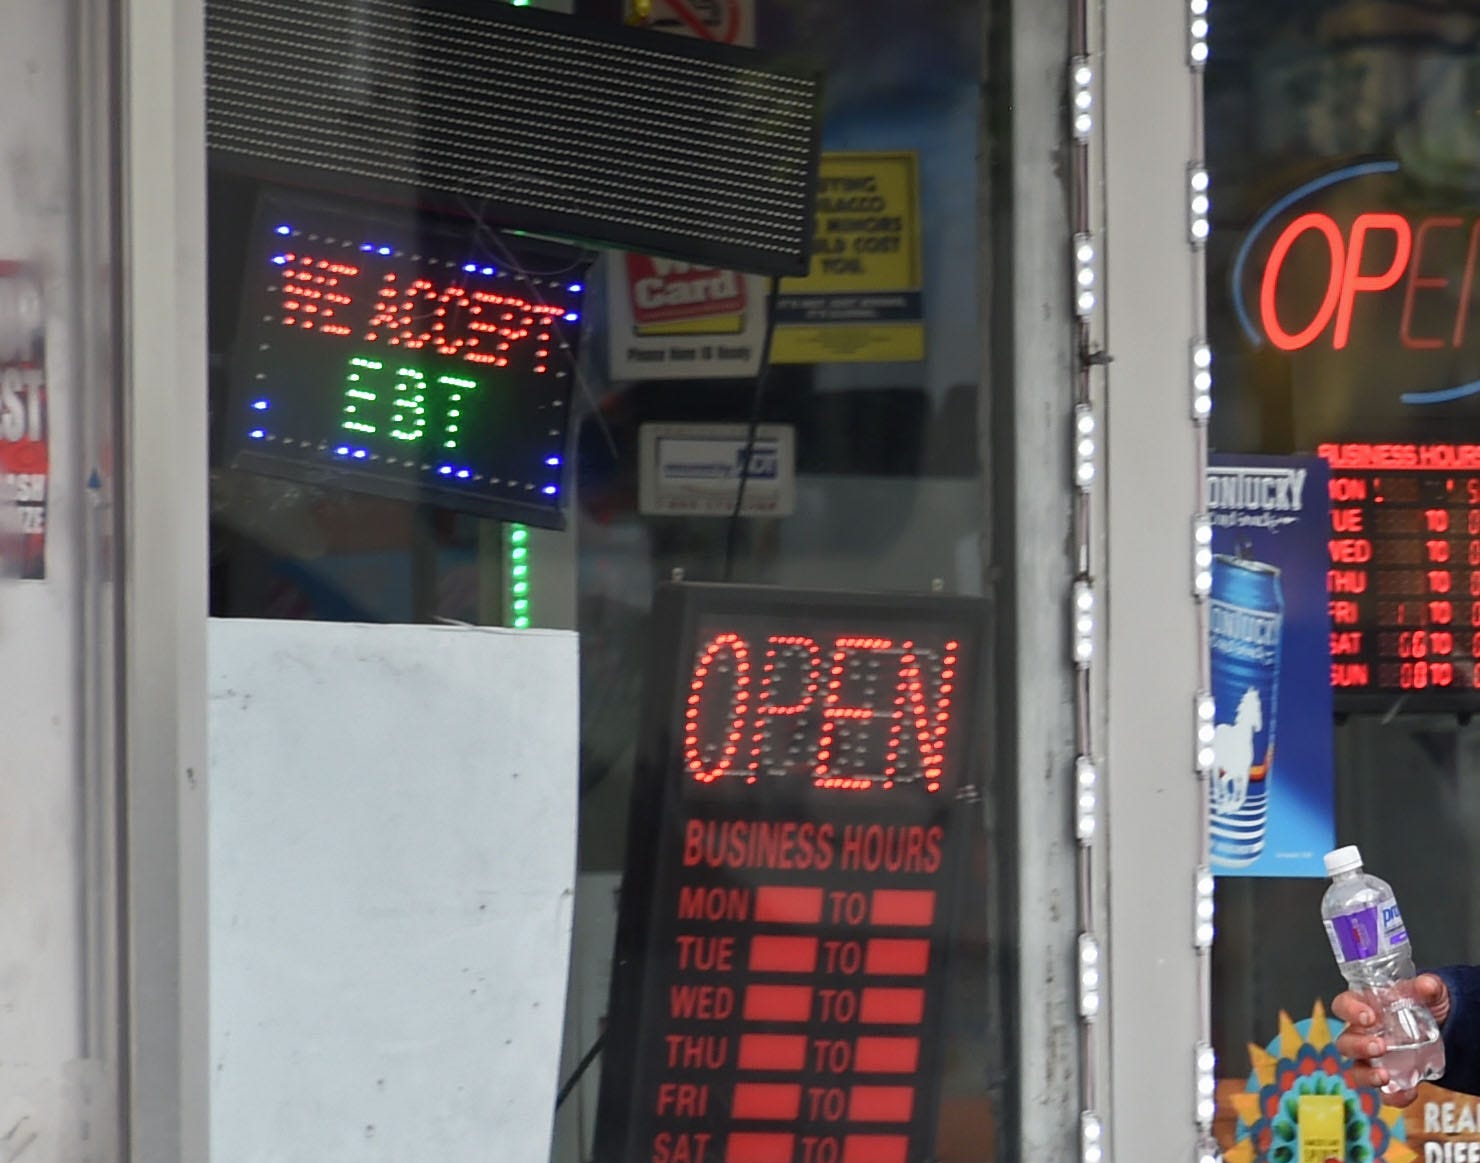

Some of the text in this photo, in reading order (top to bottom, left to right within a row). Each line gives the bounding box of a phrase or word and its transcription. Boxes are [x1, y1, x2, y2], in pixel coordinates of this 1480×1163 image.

[634, 274, 738, 310] Card
[342, 356, 478, 446] EBT
[684, 632, 960, 791] OPEN
[683, 819, 944, 874] BUSINESS HOURS
[678, 886, 867, 925] MON TO
[676, 935, 861, 976] TUE TO
[670, 984, 856, 1024] WED TO
[665, 1034, 851, 1074] THU TO
[657, 1083, 845, 1123] FRI TO
